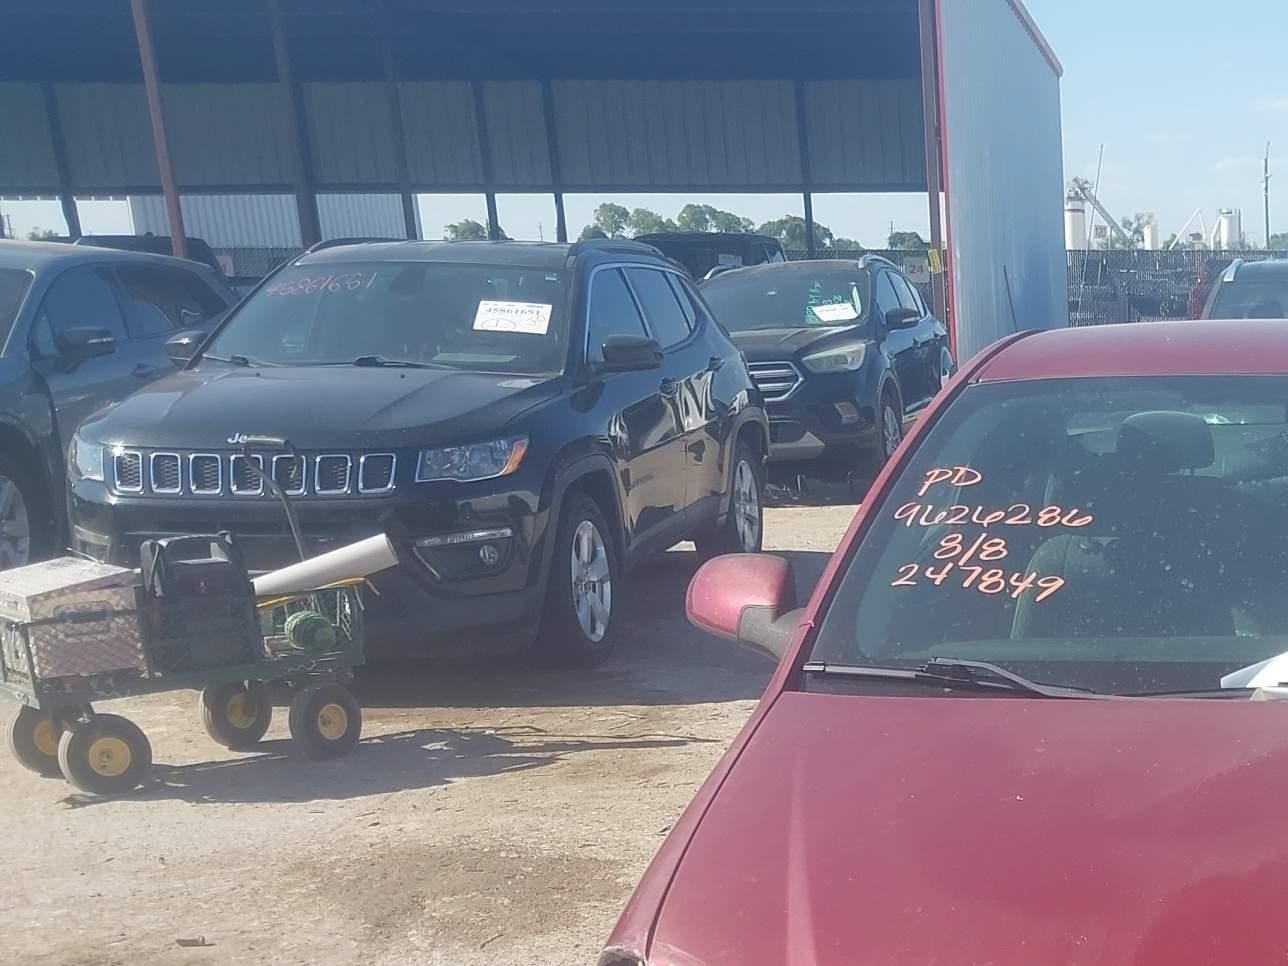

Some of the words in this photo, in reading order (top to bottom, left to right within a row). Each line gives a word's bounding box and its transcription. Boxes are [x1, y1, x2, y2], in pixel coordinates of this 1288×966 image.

[909, 264, 924, 274] 24
[917, 466, 982, 497] PD
[894, 502, 1094, 528] 9626286
[933, 533, 1009, 566] 8/8
[890, 562, 1065, 602] 247849
